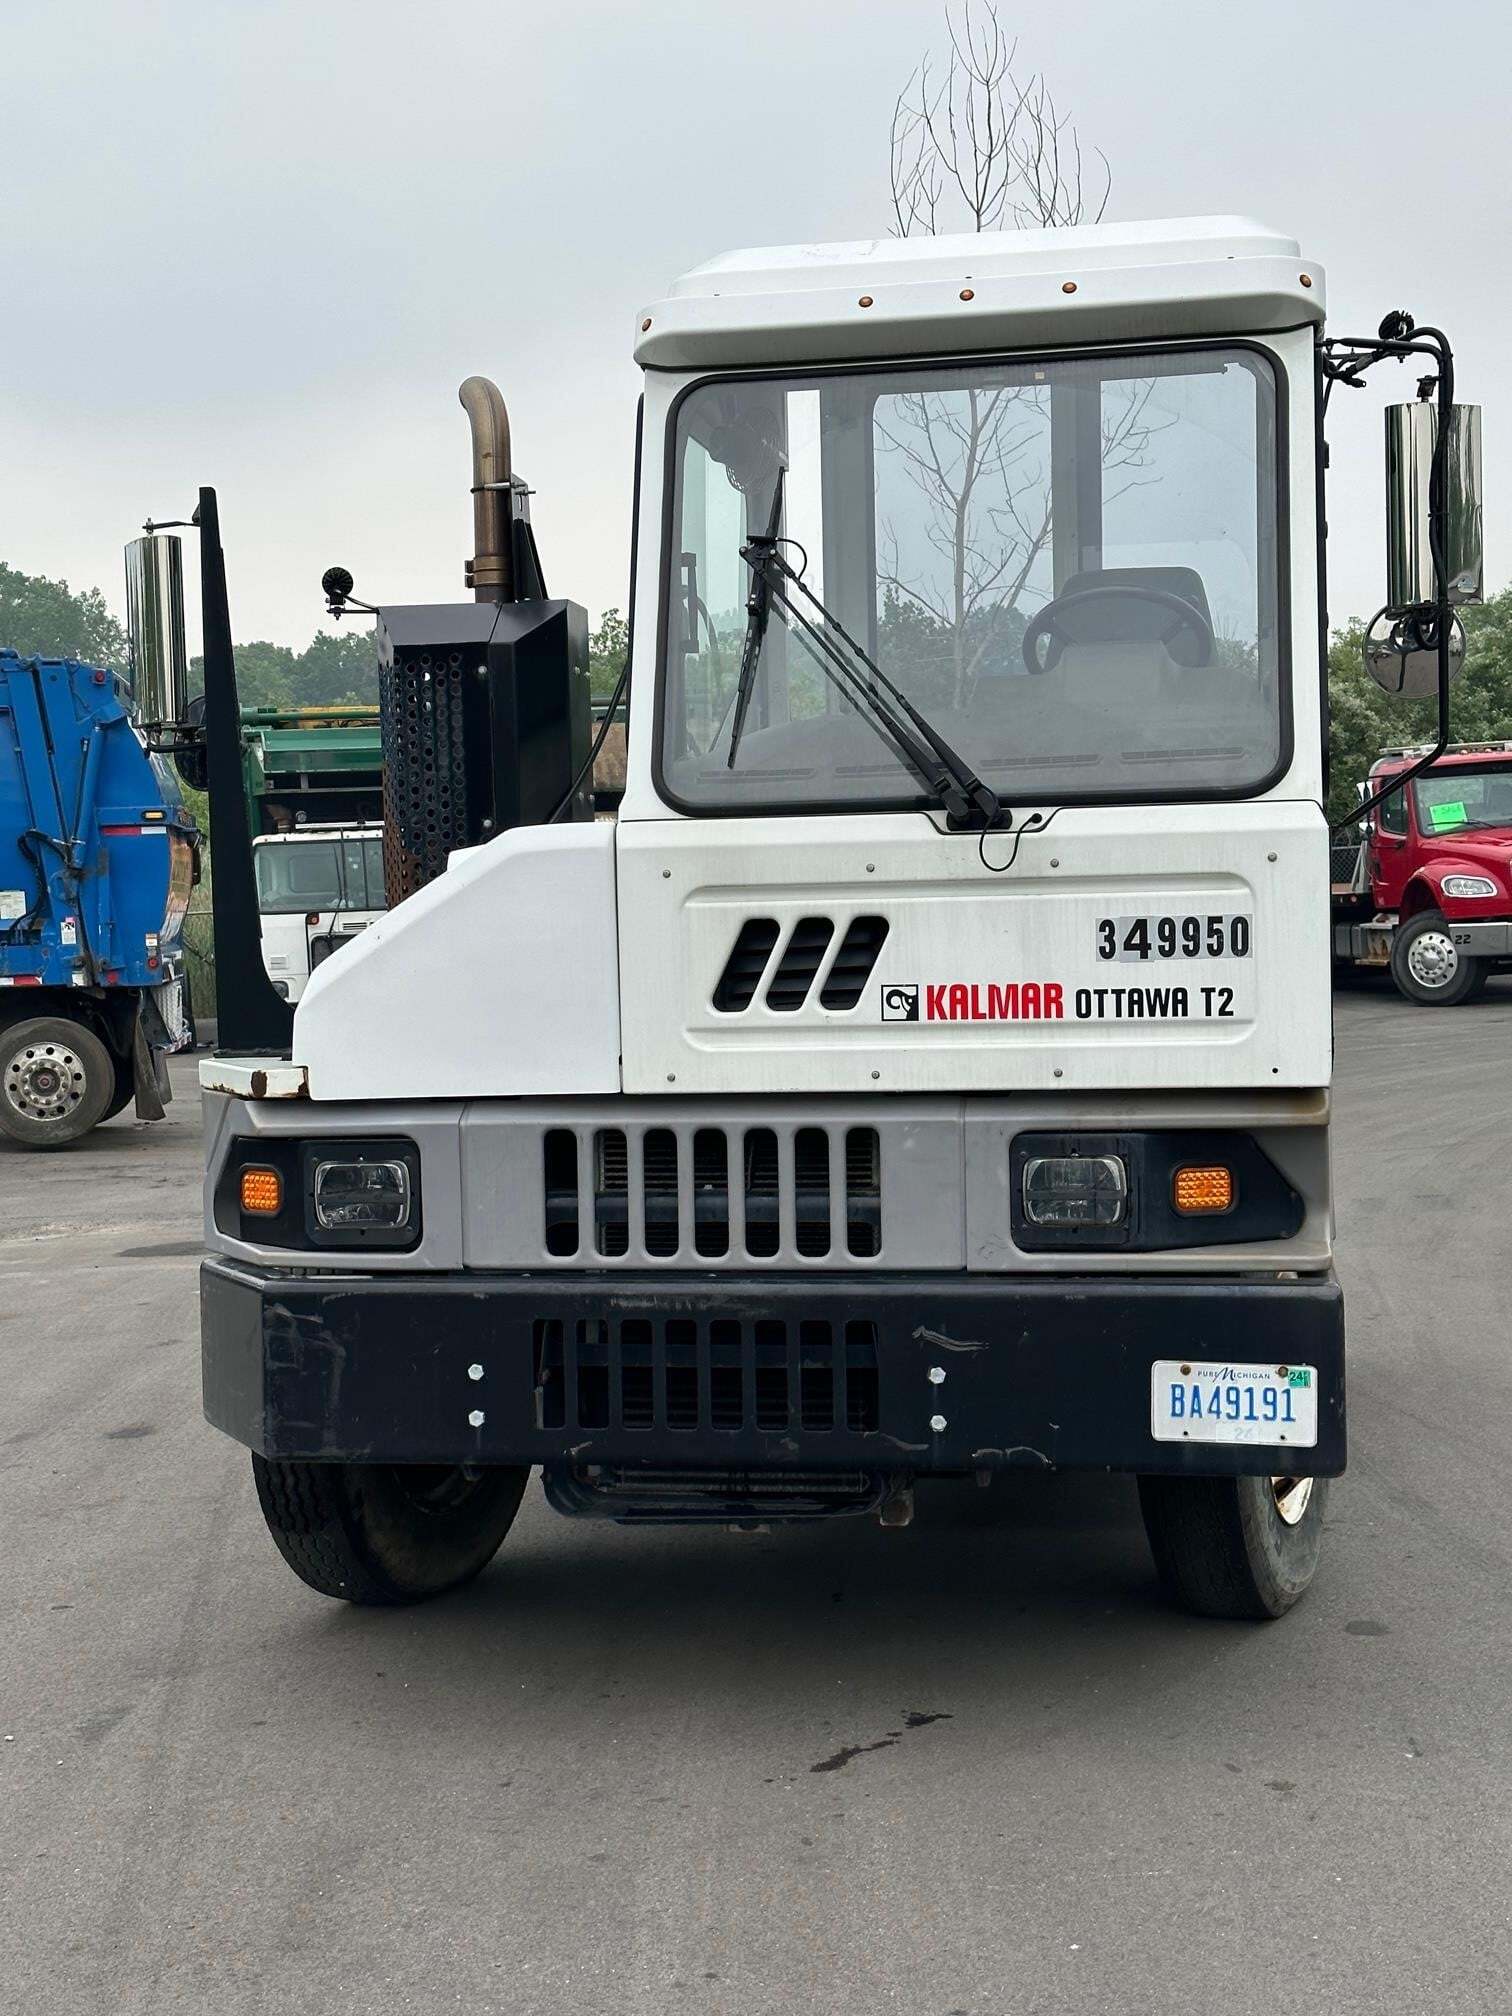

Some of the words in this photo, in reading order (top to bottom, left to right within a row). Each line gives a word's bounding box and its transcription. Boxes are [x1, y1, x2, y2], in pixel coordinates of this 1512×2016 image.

[1098, 915, 1250, 960] 349950
[1455, 934, 1471, 945] 22
[926, 982, 1064, 1021] KALMAR
[1075, 987, 1189, 1019] OTTAWA
[1200, 987, 1235, 1017] T2
[1289, 1371, 1304, 1382] 24
[1170, 1383, 1296, 1423] BA49191
